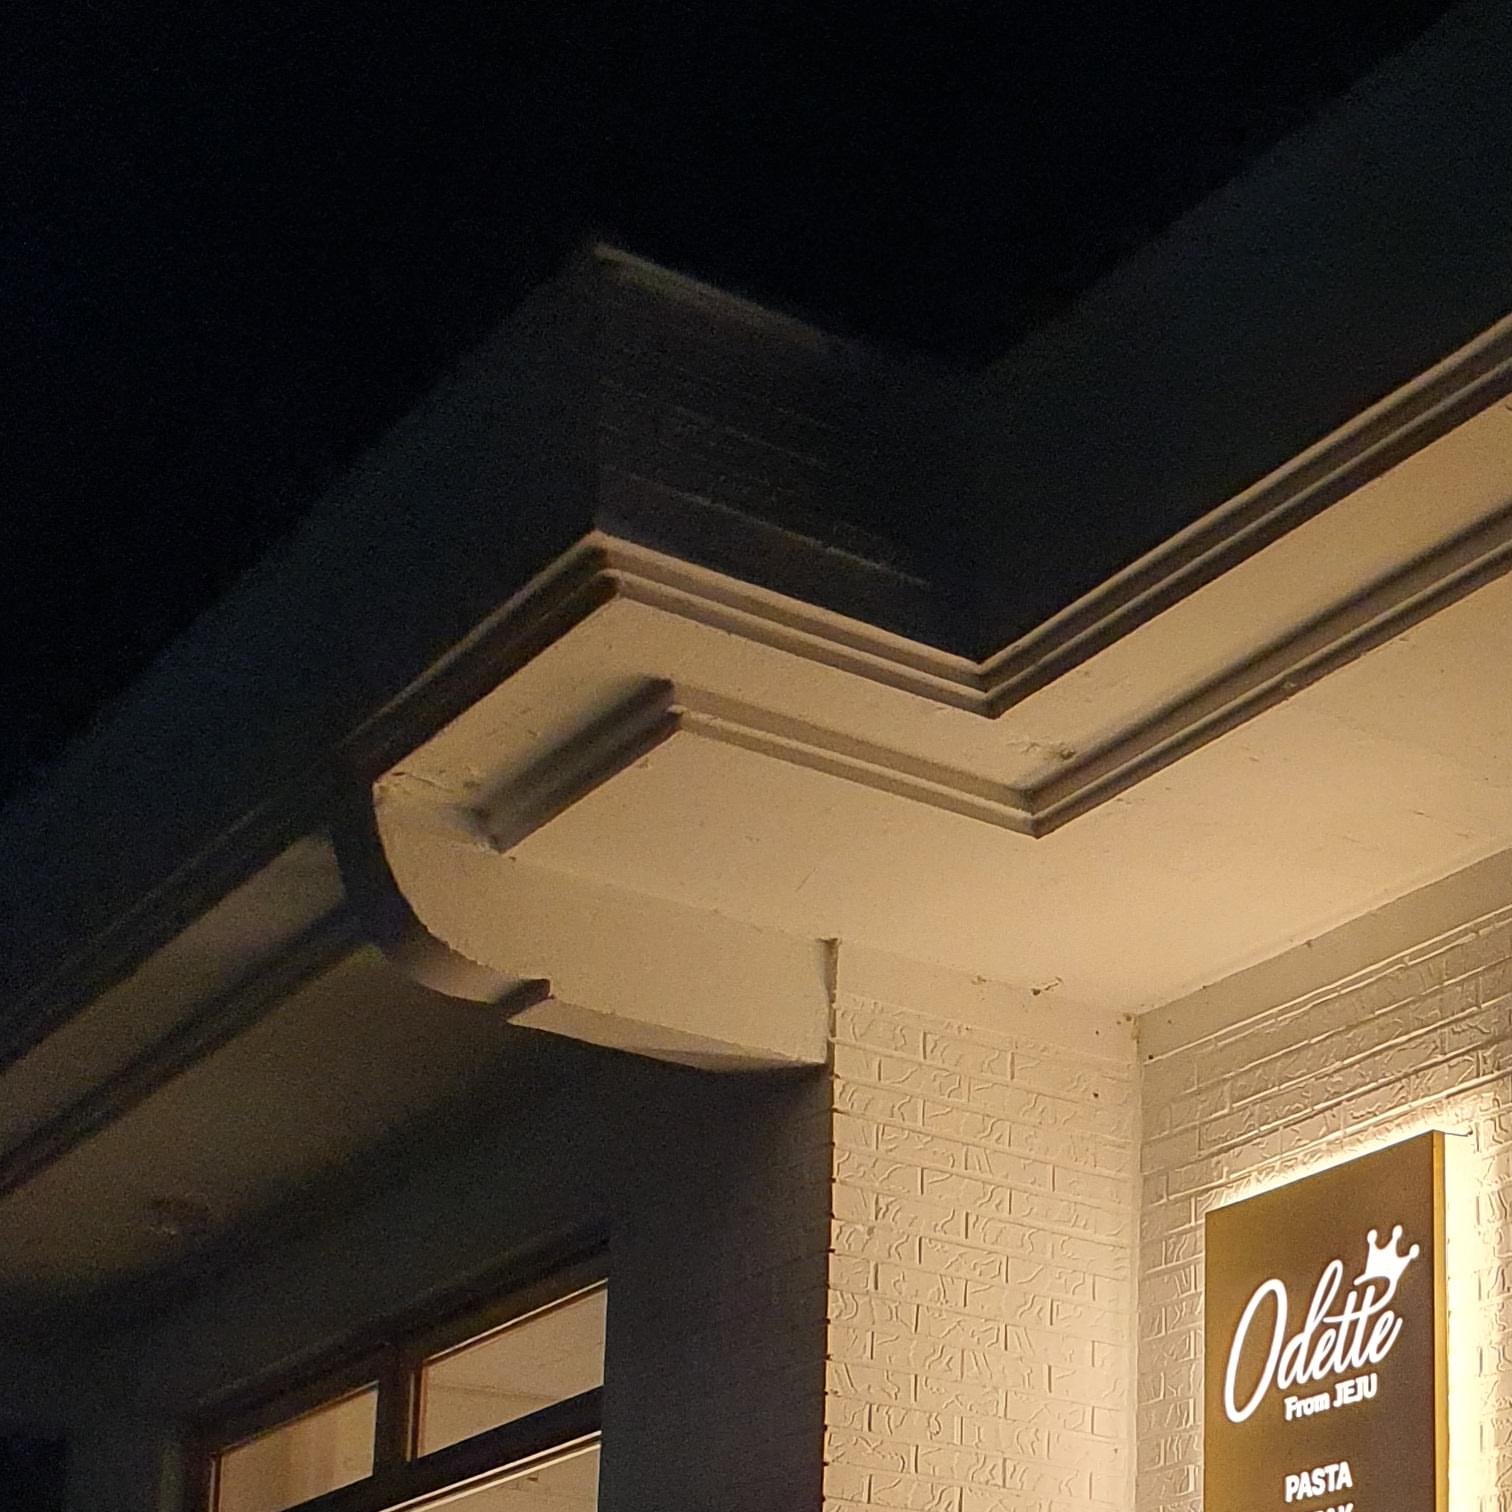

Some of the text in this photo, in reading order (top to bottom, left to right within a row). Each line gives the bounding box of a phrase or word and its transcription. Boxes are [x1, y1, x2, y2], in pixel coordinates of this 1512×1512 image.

[1224, 1258, 1404, 1423] Odette
[1284, 1372, 1378, 1421] From JEJU
[1285, 1461, 1353, 1503] PASTA
